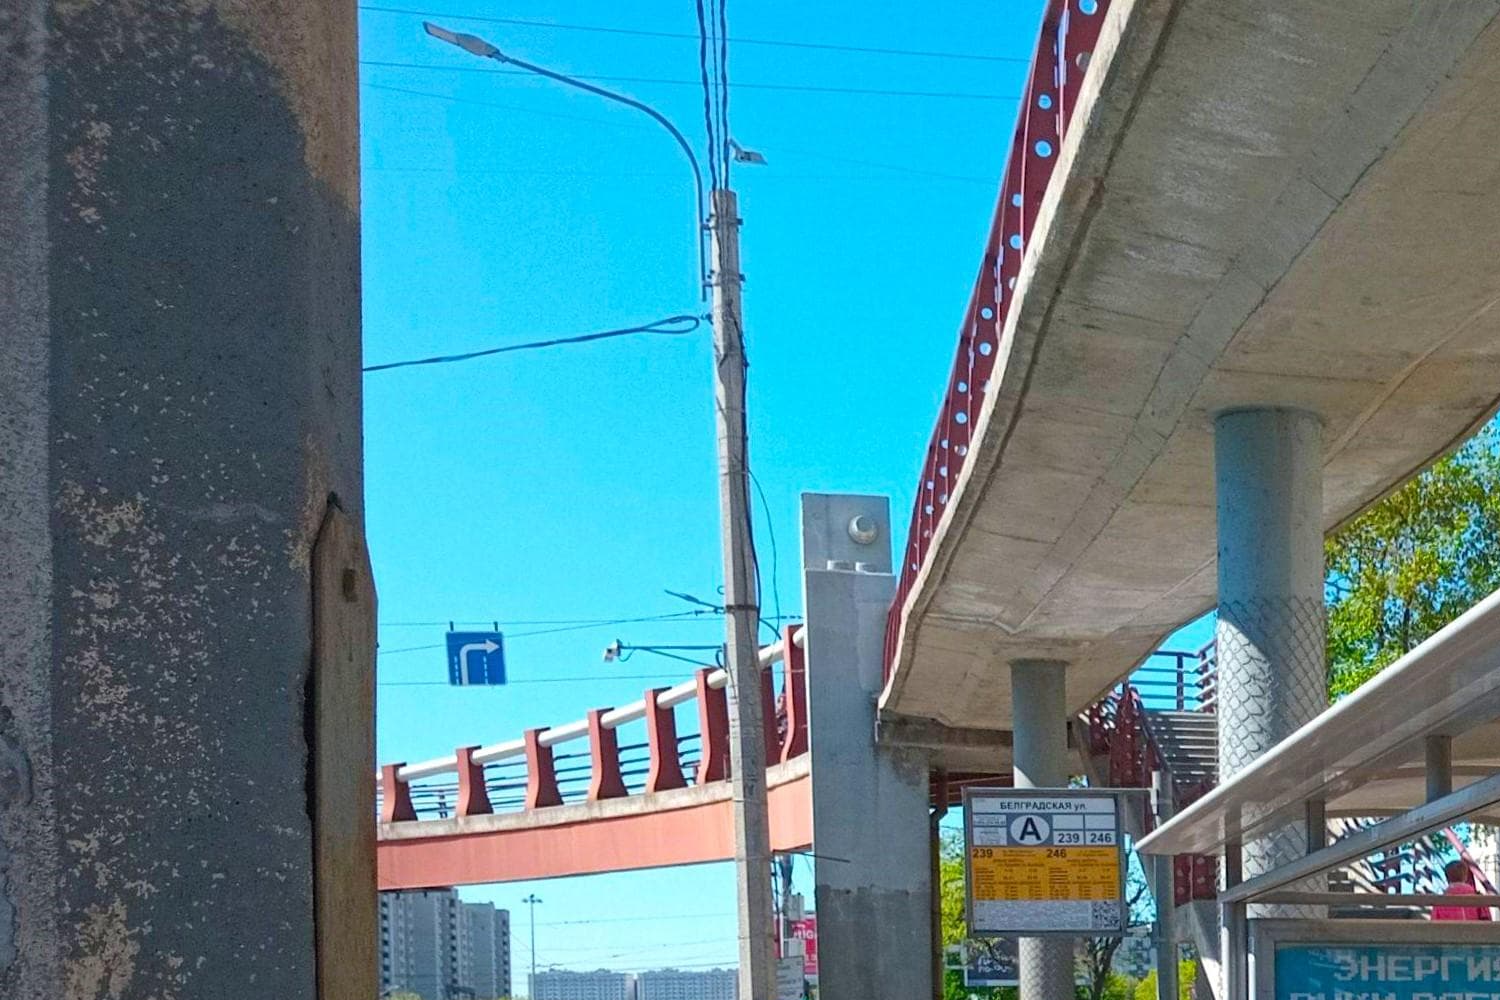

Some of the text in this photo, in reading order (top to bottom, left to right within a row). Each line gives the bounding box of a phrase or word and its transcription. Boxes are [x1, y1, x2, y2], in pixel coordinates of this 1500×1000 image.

[1000, 801, 1072, 810] БЕЛГРАДСКАЯ
[1019, 817, 1042, 840] А
[1058, 832, 1112, 843] 239 246
[973, 848, 993, 858] 239
[1047, 848, 1067, 858] 246
